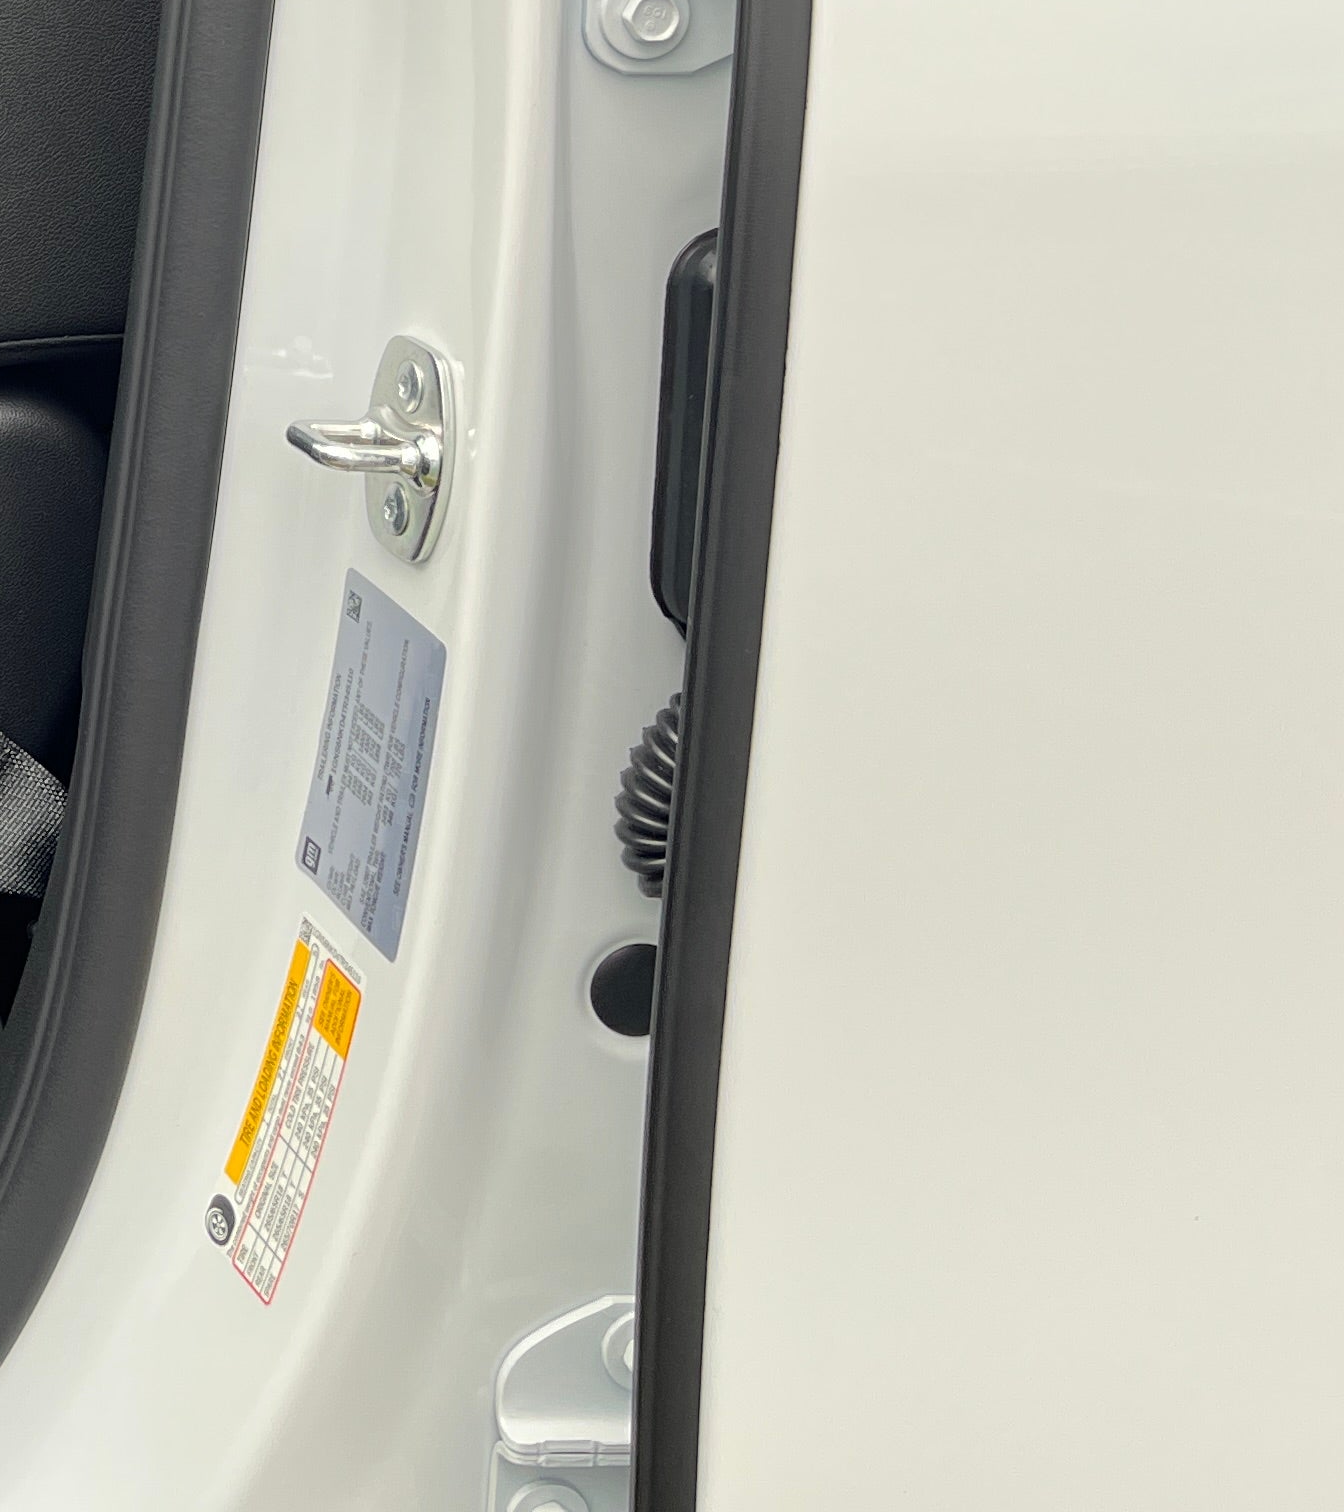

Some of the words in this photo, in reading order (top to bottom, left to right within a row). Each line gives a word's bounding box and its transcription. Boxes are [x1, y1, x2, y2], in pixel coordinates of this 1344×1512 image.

[325, 670, 342, 733] INFORMATION
[416, 694, 431, 751] INFORMATION
[412, 748, 423, 776] MORE
[410, 772, 419, 793] FOR
[401, 807, 413, 845] MANUAL
[268, 975, 300, 1054] INFORMATION
[254, 1046, 278, 1101] LOADING
[296, 1040, 315, 1088] PRESSURE
[247, 1093, 263, 1123] AND
[291, 1084, 302, 1106] TIRE
[283, 1102, 296, 1131] COLD
[238, 1117, 255, 1148] TIRE
[267, 1158, 279, 1182] SIZE
[253, 1177, 273, 1222] ORIGINAL
[236, 1240, 249, 1266] TIRE
